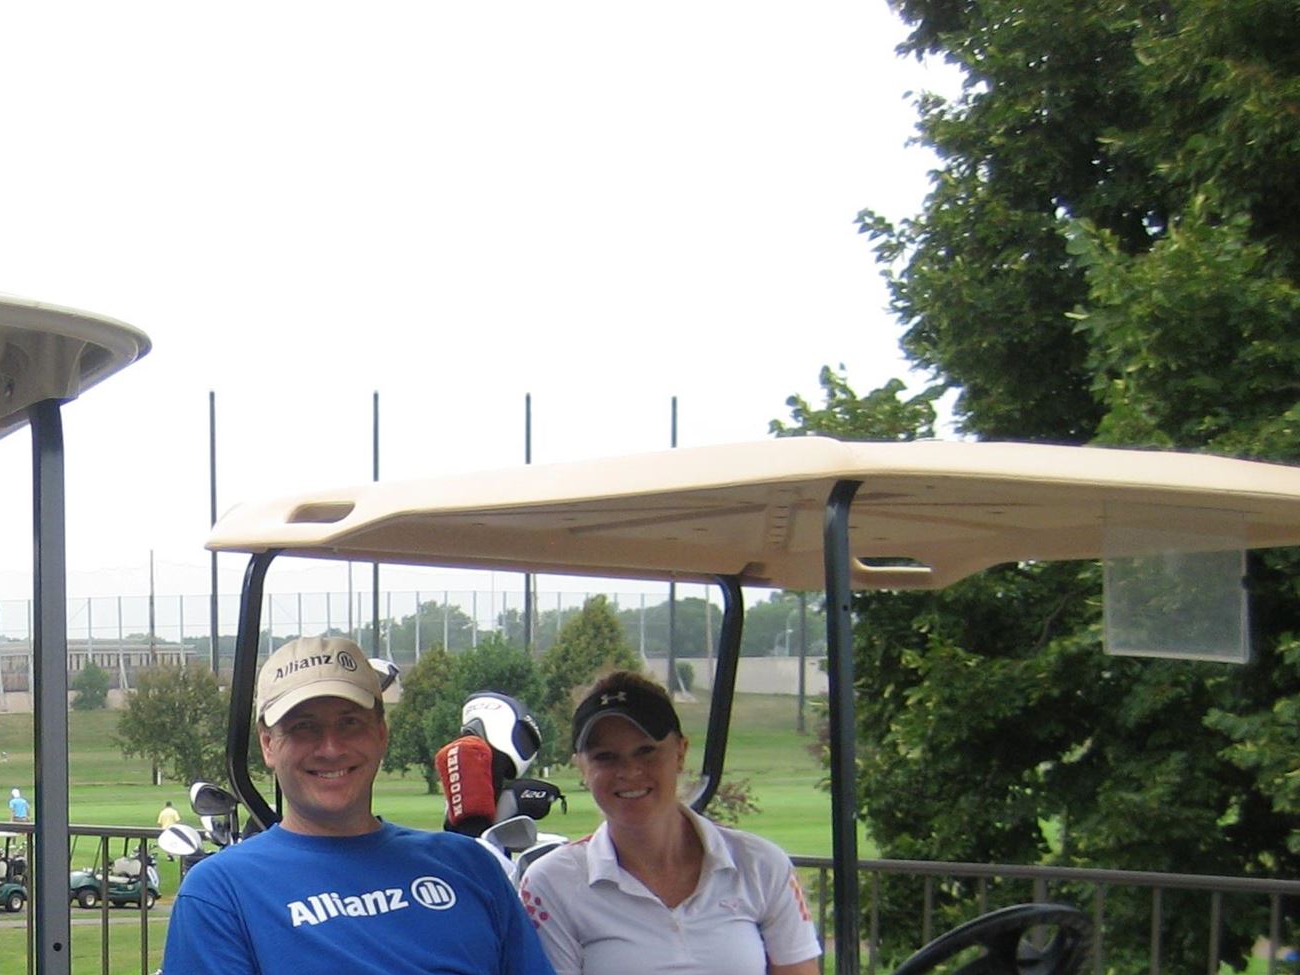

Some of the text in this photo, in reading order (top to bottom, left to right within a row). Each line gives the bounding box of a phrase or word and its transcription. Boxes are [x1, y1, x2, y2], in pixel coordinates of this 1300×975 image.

[274, 654, 333, 682] Allianz
[447, 746, 464, 817] HOOSIER
[287, 888, 409, 928] Allianz
